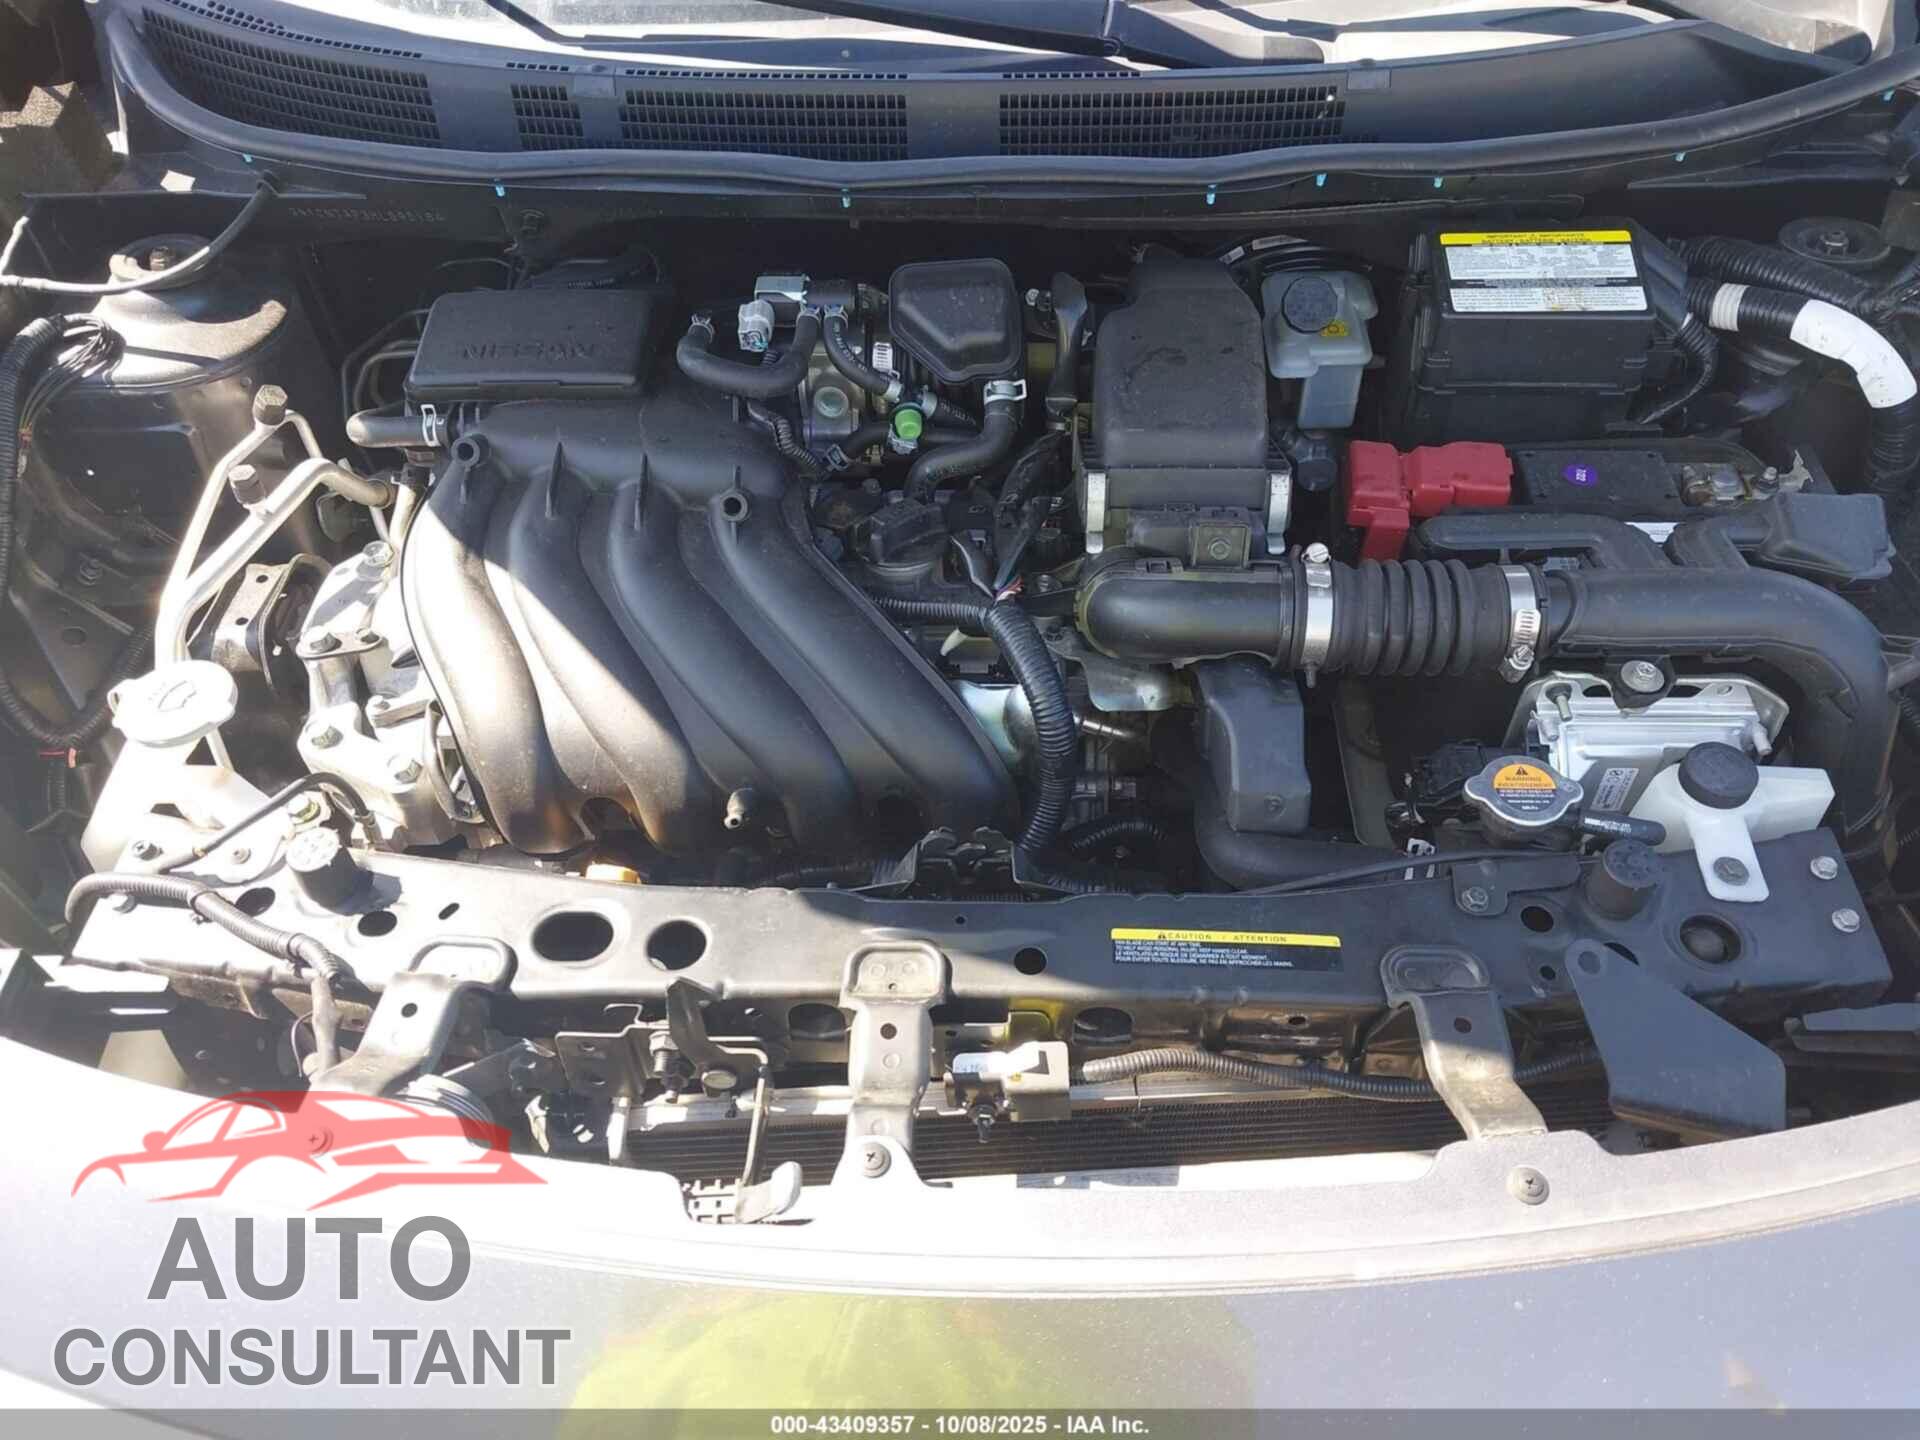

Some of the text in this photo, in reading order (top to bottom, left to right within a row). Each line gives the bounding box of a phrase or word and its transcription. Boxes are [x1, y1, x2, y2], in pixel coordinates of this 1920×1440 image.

[463, 344, 594, 361] NISSAN
[1167, 932, 1212, 940] CAUTION
[1233, 934, 1287, 942] ATTENTION
